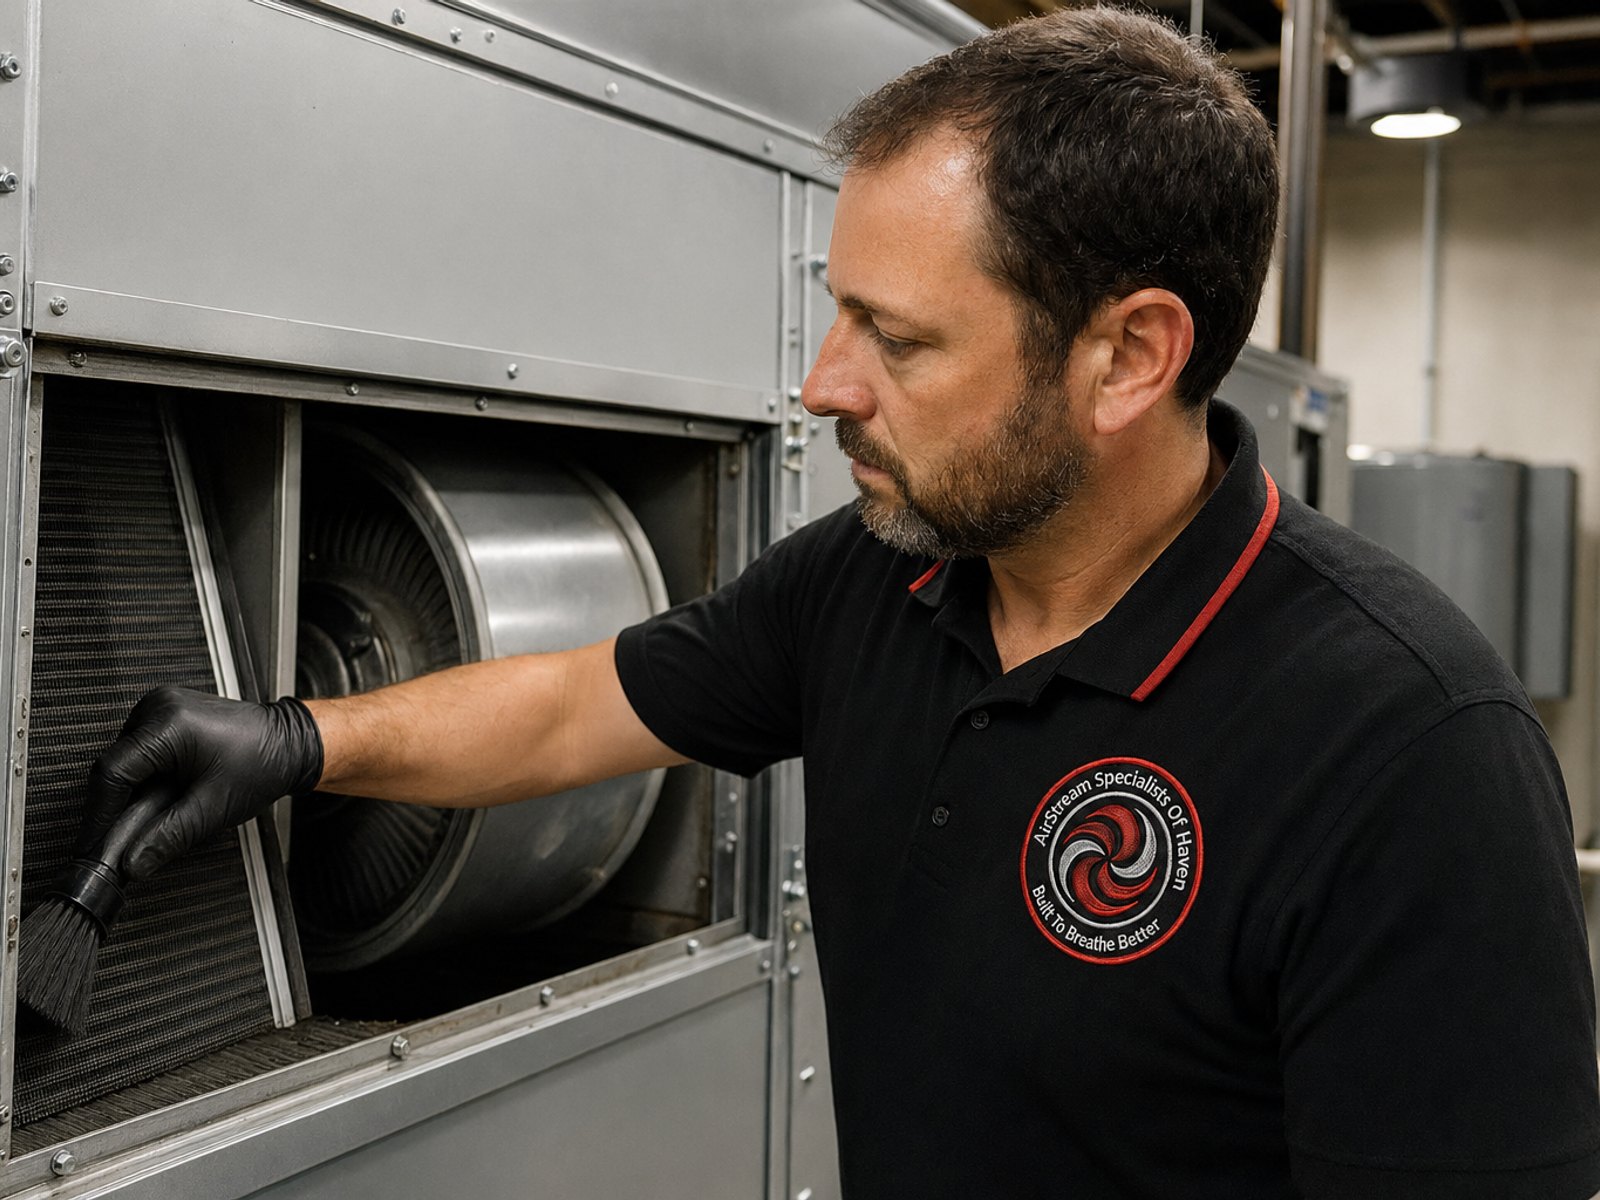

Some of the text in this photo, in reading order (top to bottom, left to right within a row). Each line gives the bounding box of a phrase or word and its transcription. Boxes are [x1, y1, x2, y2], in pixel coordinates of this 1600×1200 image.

[1033, 770, 1193, 891] AirStream Specialists Of Haven
[1032, 884, 1161, 952] Built To Breathe Better
